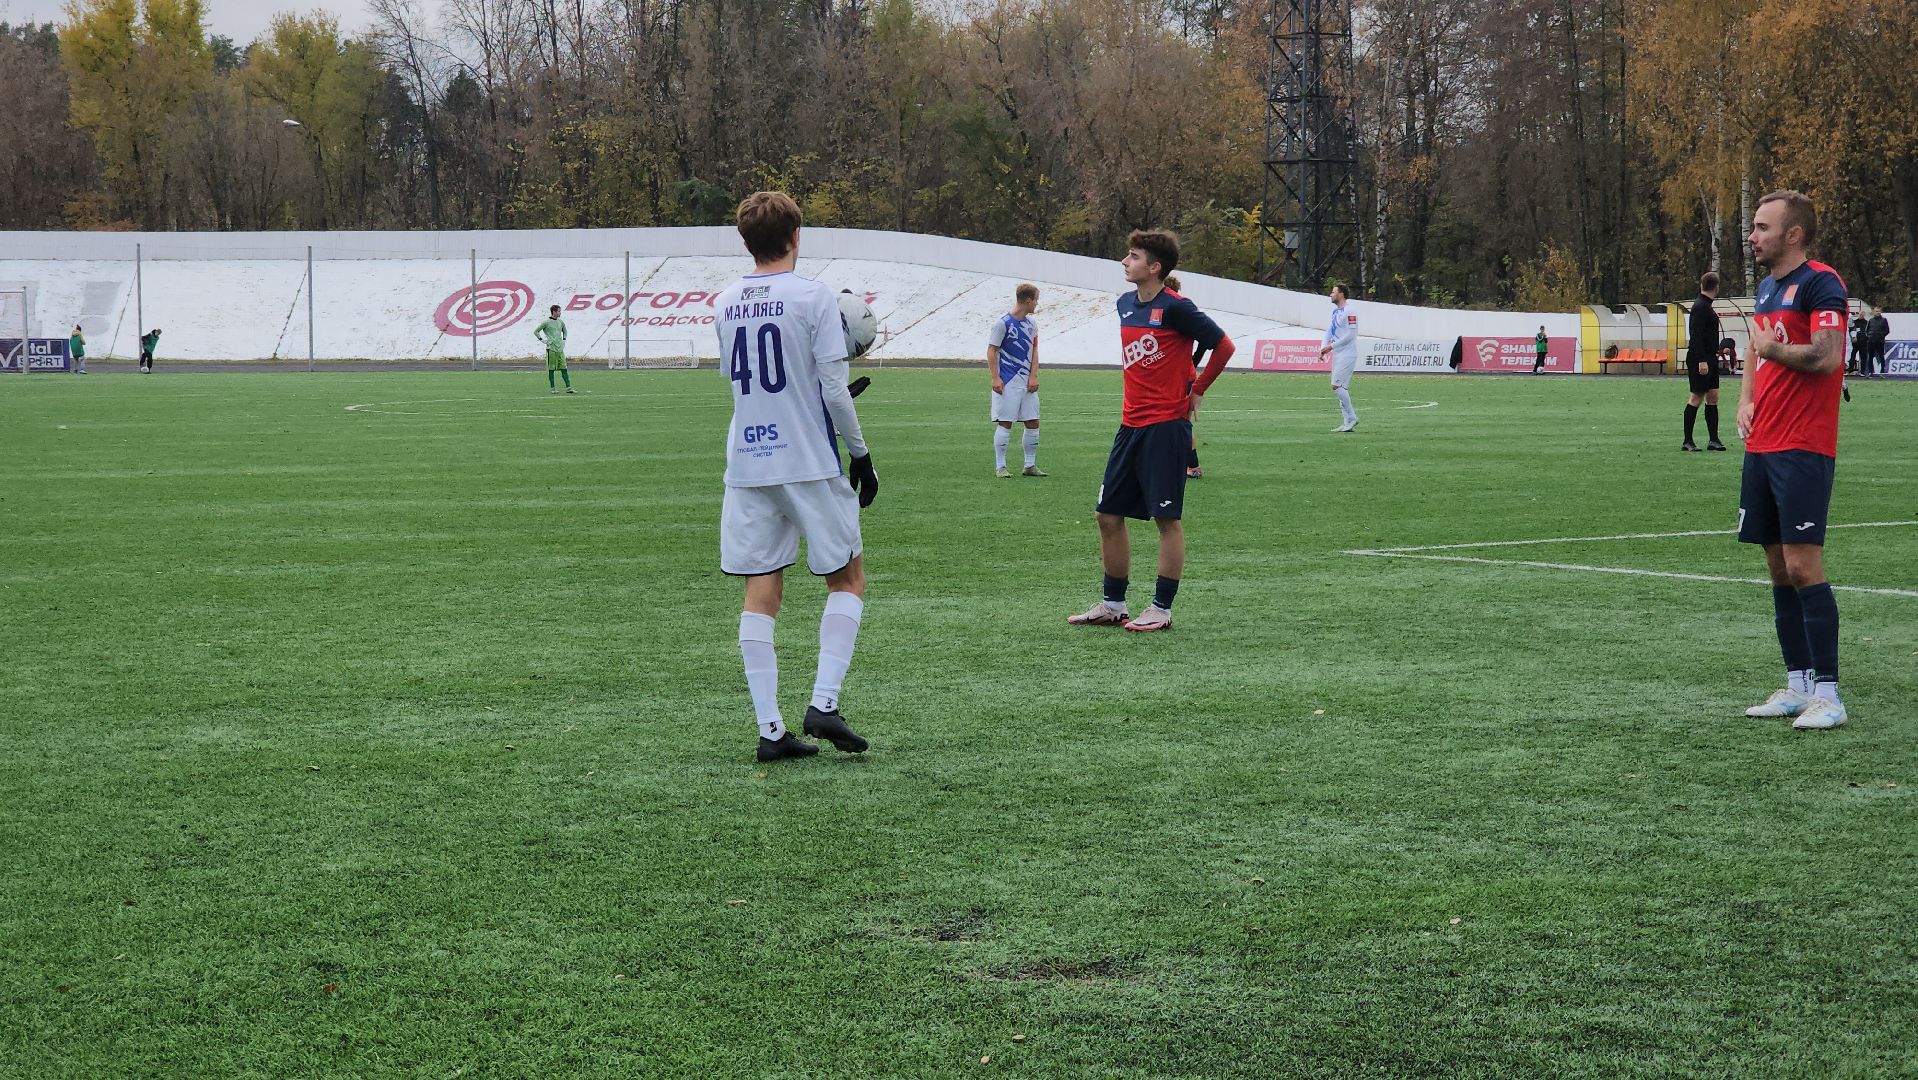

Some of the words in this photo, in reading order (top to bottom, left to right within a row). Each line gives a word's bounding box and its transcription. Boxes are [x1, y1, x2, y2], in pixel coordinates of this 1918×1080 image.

[724, 301, 784, 322] МАКЛЯЕВ
[1373, 343, 1402, 352] БИЛЕТЫ
[1404, 343, 1415, 352] НА
[1417, 341, 1440, 352] САЙТЕ
[731, 322, 787, 396] 40
[1141, 351, 1165, 367] COFFEE
[1500, 356, 1557, 366] ТЕЛЕКМ
[743, 423, 779, 443] GPS
